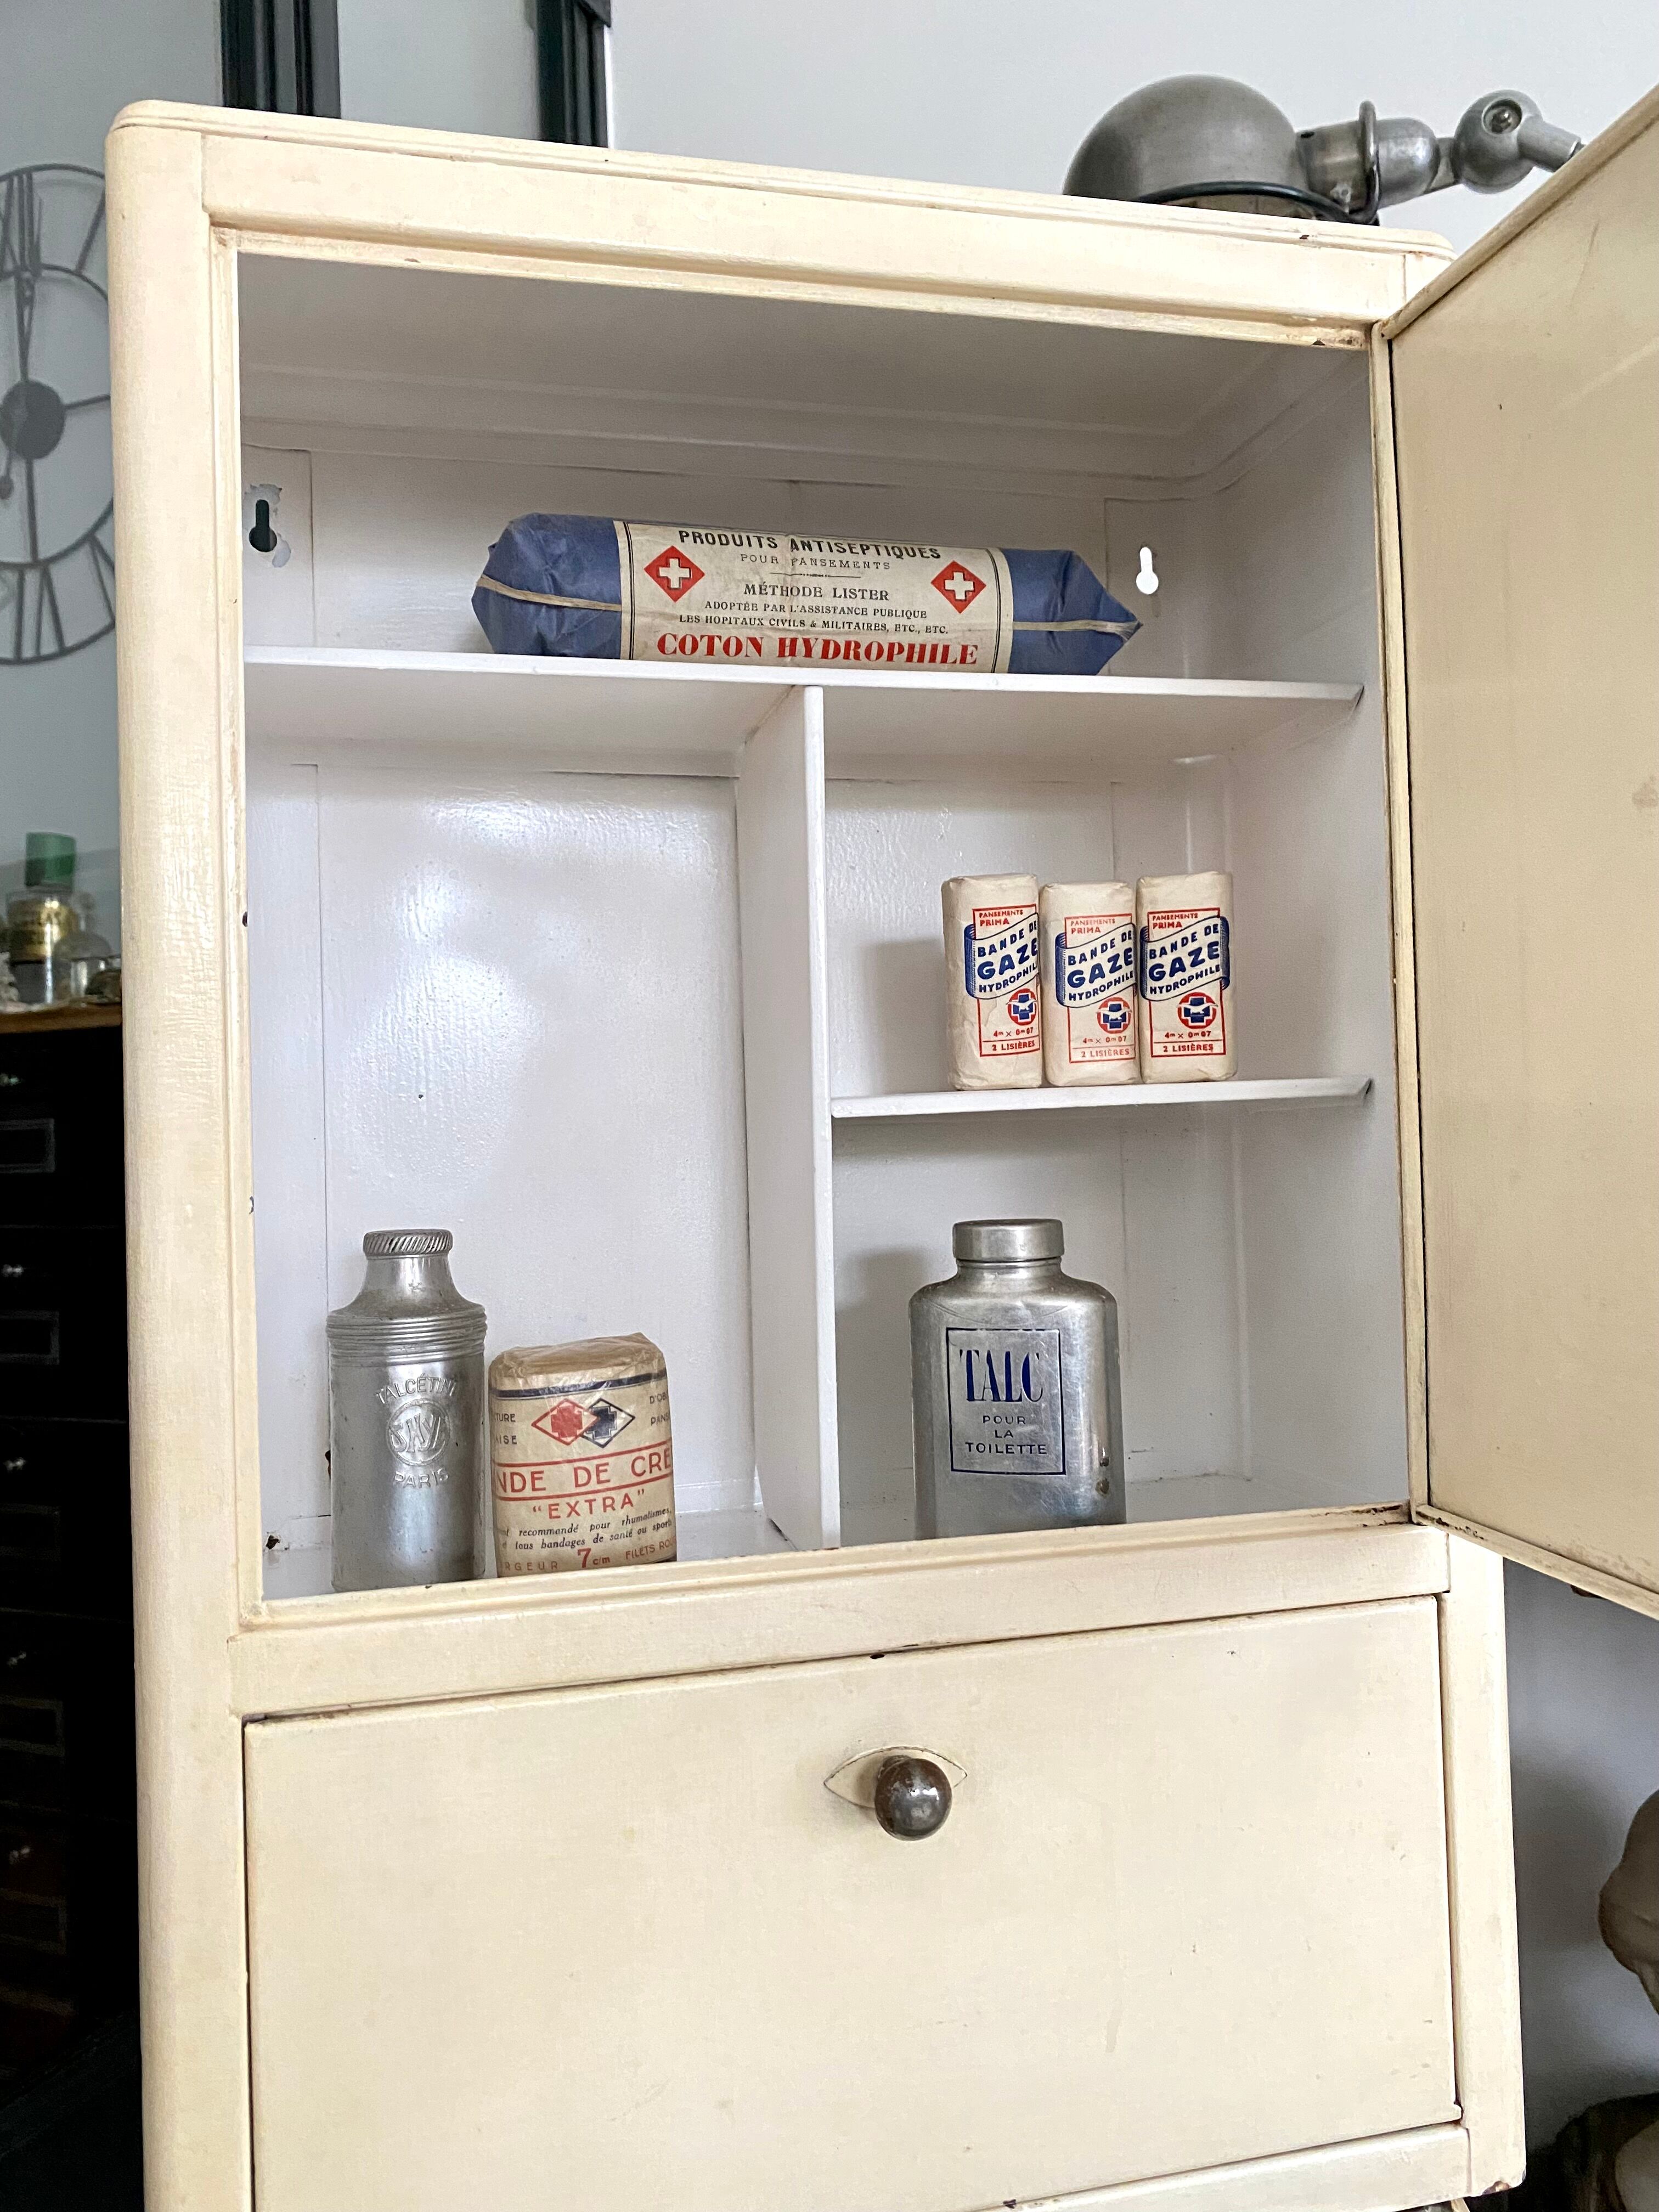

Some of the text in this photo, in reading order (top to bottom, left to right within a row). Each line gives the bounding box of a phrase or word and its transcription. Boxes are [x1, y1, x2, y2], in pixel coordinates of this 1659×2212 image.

[679, 530, 941, 560] PRODUITS ANTISEPTIQUES
[741, 554, 890, 569] POUR PANSEMENTS
[743, 582, 890, 601] MÉTHODE LISTER
[705, 601, 927, 620] ADOPTÉE PAR L'ASSISTANCE PUBLIQUE
[679, 614, 701, 624] LES
[705, 616, 764, 626] HOPITAUX
[769, 618, 806, 628] CIVILS
[821, 620, 889, 633] MILITAIRES,
[925, 625, 949, 634] ETC.
[657, 633, 978, 665] COTON HYDROPHILE
[979, 909, 1023, 918] PANSEMENTS
[980, 918, 1010, 927] PRIMA
[1070, 918, 1116, 926] PANSEMENTS
[1152, 913, 1198, 921] PANSEMENTS
[1071, 926, 1102, 935] PRIMA
[1153, 921, 1183, 929] PRIMA
[978, 920, 1037, 957] BANDE DE
[1068, 930, 1132, 966] BANDE DE
[1149, 923, 1219, 960] BANDE DE
[977, 937, 1038, 980] GAZE
[1067, 947, 1133, 988] GAZE
[1148, 940, 1220, 982] GAZE
[979, 963, 1037, 993] HYDROPHIL
[1069, 970, 1133, 1001] HYDROPHILE
[1149, 964, 1220, 995] HYDROPHILE
[1001, 1039, 1035, 1051] LISIÈRES
[1090, 1046, 1130, 1057] LISIÈRES
[1172, 1042, 1214, 1052] LISIÈRES
[959, 1348, 1043, 1402] TALC
[983, 1415, 1026, 1425] POUR
[995, 1429, 1014, 1438] LA
[965, 1442, 1047, 1454] TOILETTE
[393, 1468, 449, 1488] PARIS
[573, 1462, 611, 1488] DE
[518, 1525, 579, 1537] recommandé
[589, 1521, 611, 1533] pour
[515, 1538, 534, 1550] tous
[541, 1537, 585, 1553] bandages
[592, 1532, 604, 1544] de
[609, 1529, 633, 1542] santé
[637, 1526, 647, 1535] ou
[500, 1560, 558, 1572] RGEUR
[577, 1547, 592, 1569] 7
[625, 1545, 656, 1560] FILETS
